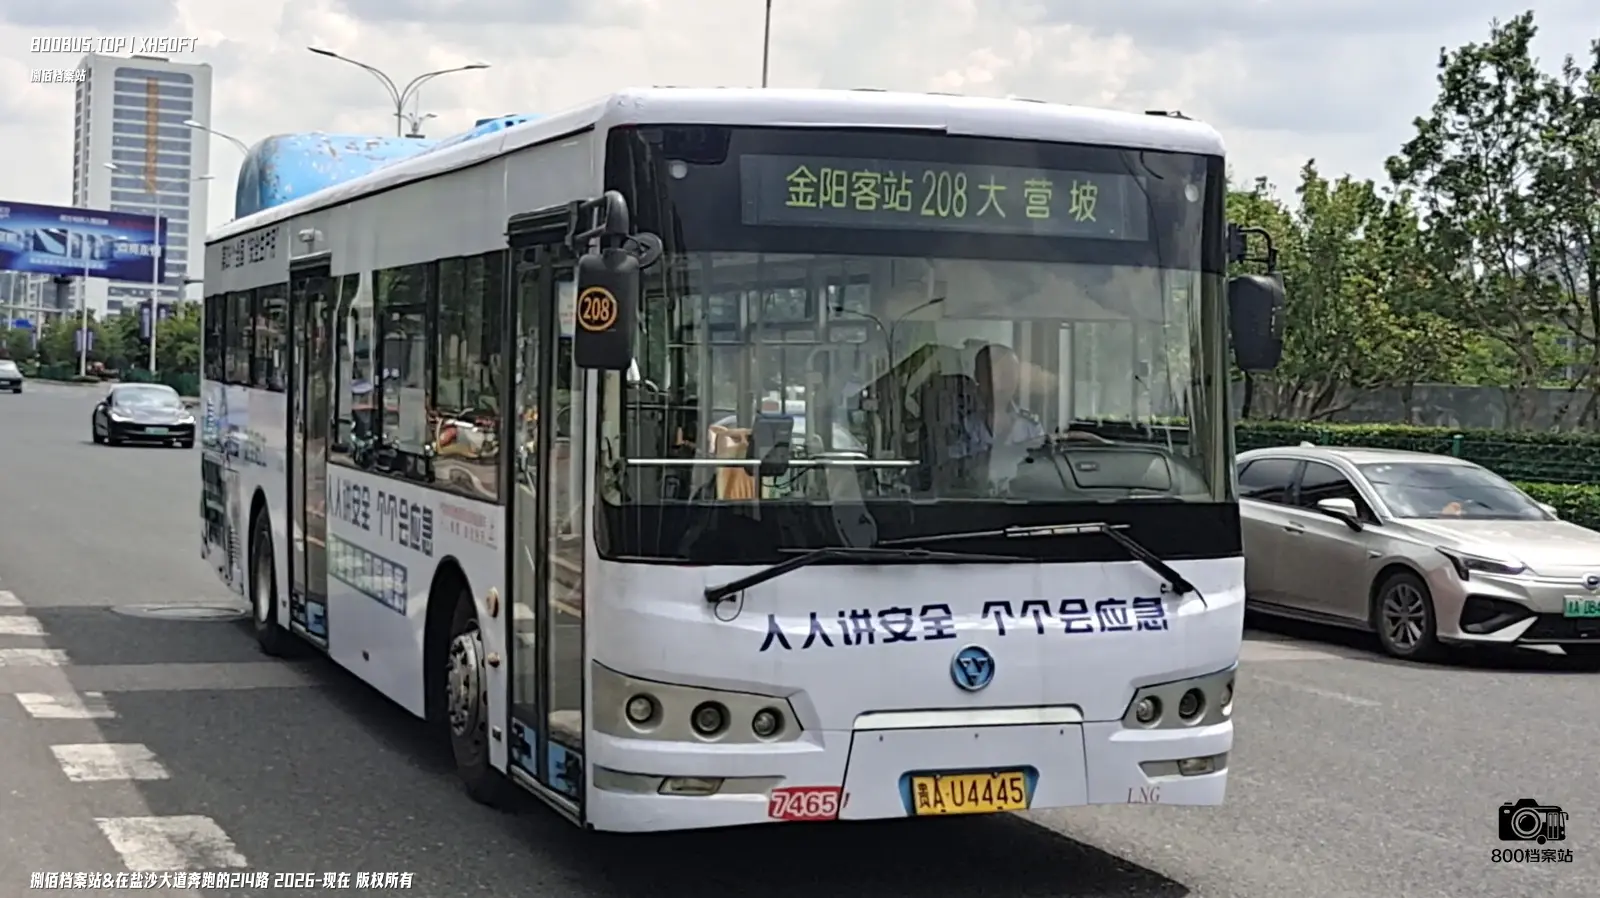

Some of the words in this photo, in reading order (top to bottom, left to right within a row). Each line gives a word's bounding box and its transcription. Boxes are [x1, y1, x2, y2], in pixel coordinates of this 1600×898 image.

[785, 164, 914, 212] 金阳客站
[920, 169, 968, 218] 208
[976, 174, 1099, 223] 大营坡
[583, 297, 610, 321] 208
[759, 603, 957, 652] 人人讲安全
[981, 596, 1169, 637] 个个会应急
[772, 791, 838, 817] 7465
[1126, 786, 1161, 804] LNG
